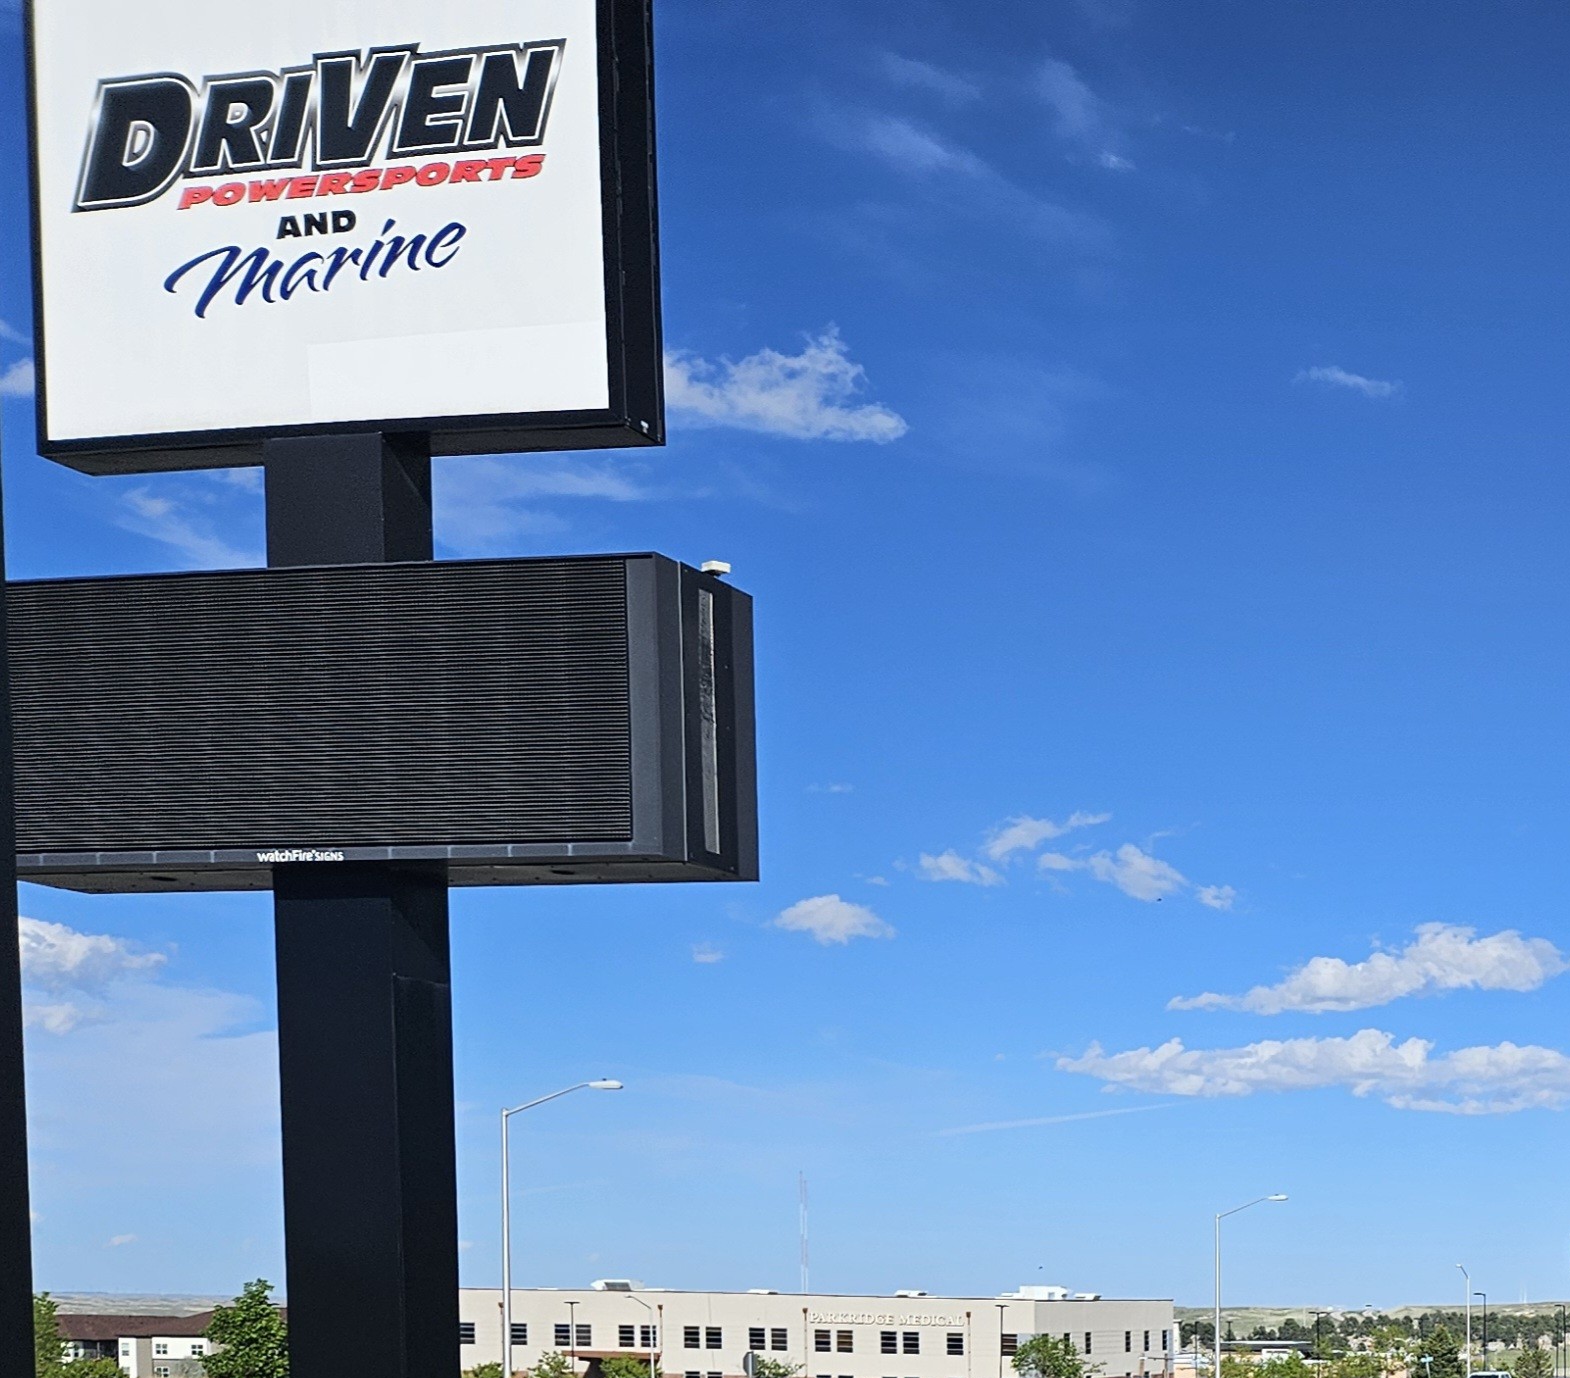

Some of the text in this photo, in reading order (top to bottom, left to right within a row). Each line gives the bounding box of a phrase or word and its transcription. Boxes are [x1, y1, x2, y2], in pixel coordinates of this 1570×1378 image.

[72, 38, 567, 213] DRIVEN
[177, 153, 547, 210] POWERSPORTS
[276, 209, 357, 240] AND
[163, 217, 467, 318] Marine
[809, 1312, 965, 1327] PARKRIDGE MEDICAL
